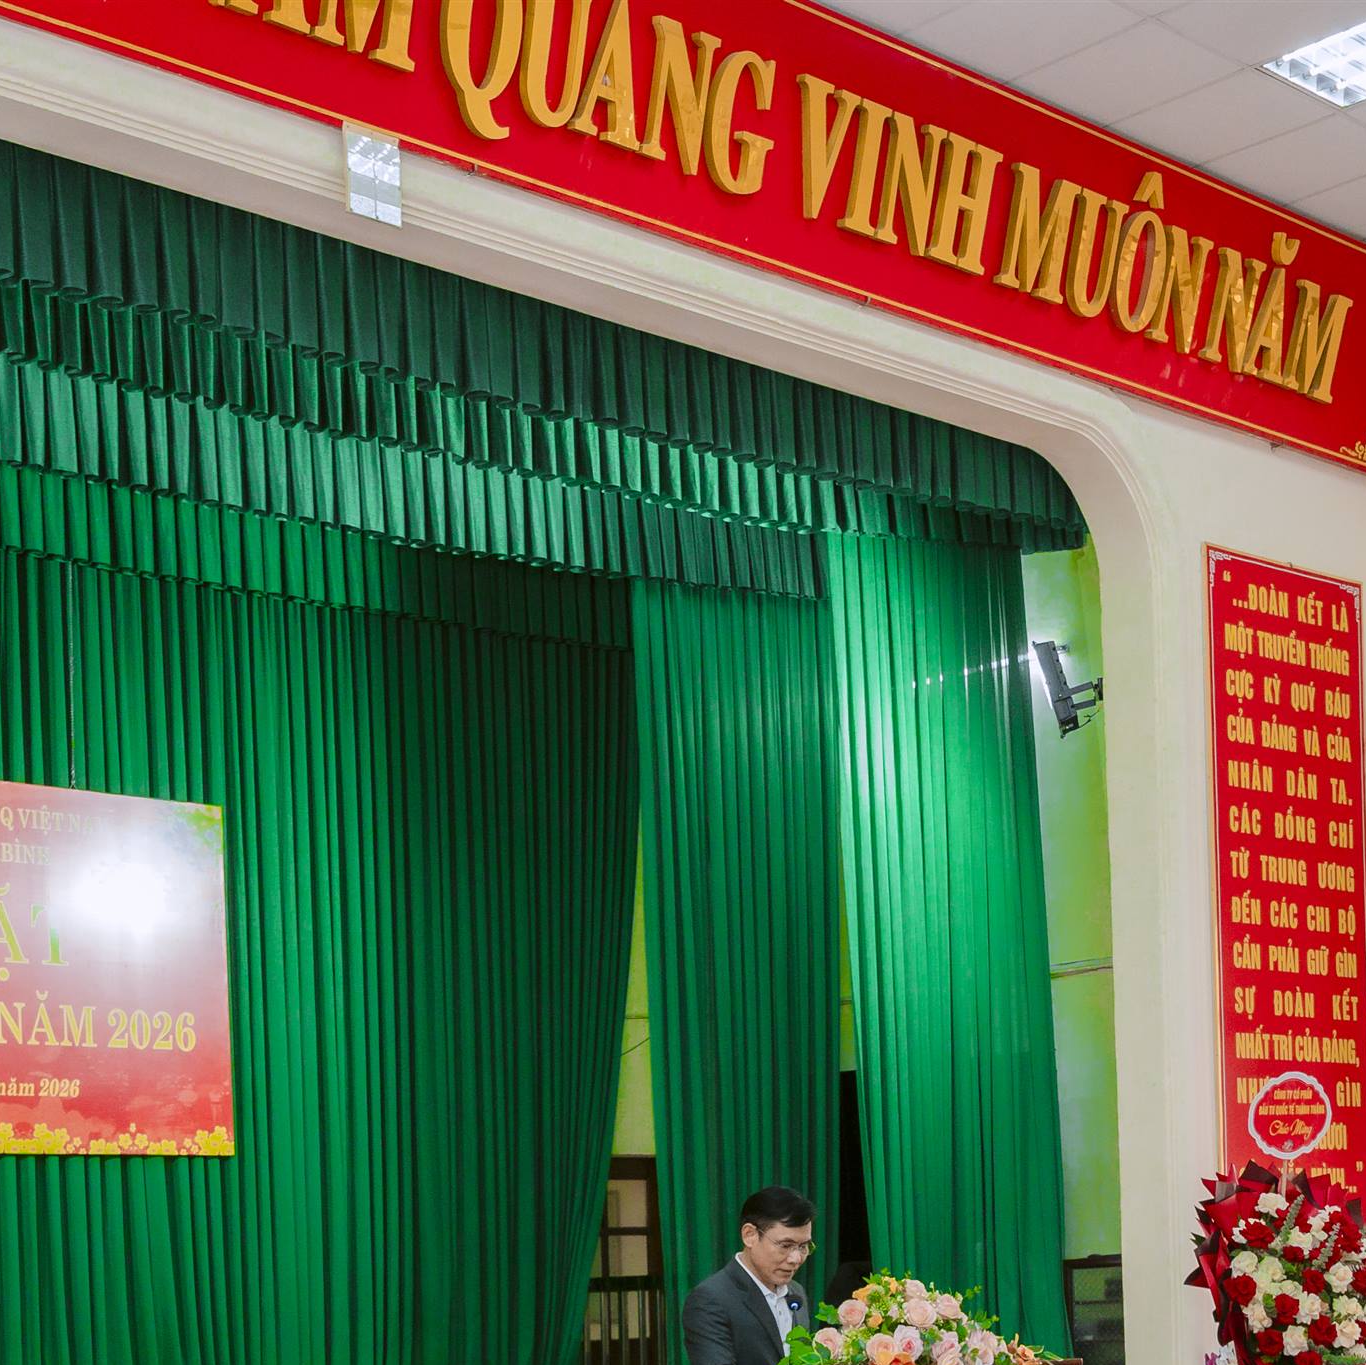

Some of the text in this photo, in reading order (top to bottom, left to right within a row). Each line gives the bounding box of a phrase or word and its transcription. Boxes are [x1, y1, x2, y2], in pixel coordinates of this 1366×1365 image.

[440, 0, 1353, 404] QUANG VINH MUÔN NĂM
[1297, 592, 1324, 627] KẾT
[1332, 601, 1349, 633] LÀ
[1224, 621, 1350, 676] MỘT TRUYỀN THỐNG
[1225, 668, 1350, 719] CỰC KỲ QUÝ BÁU
[1227, 708, 1352, 762] CỦA ĐẢNG VÀ CỦA
[1228, 758, 1353, 806] NHÂN DÂN TA.
[17, 804, 63, 834] VIỆT
[1229, 802, 1354, 849] CÁC ĐỒNG CHÍ
[1230, 846, 1355, 893] TỪ TRUNG ƯƠNG
[1231, 890, 1356, 941] ĐẾN CÁC CHI BỘ
[1233, 934, 1357, 979] CẦN PHẢI GIỮ GÌN
[1234, 985, 1358, 1022] SỰ ĐOÀN KẾT
[107, 1008, 197, 1052] 2026
[1235, 1024, 1360, 1067] NHẤT TRÍ CỦA ĐẢNG,
[39, 1078, 81, 1098] 2026
[1336, 1077, 1362, 1107] GÌN
